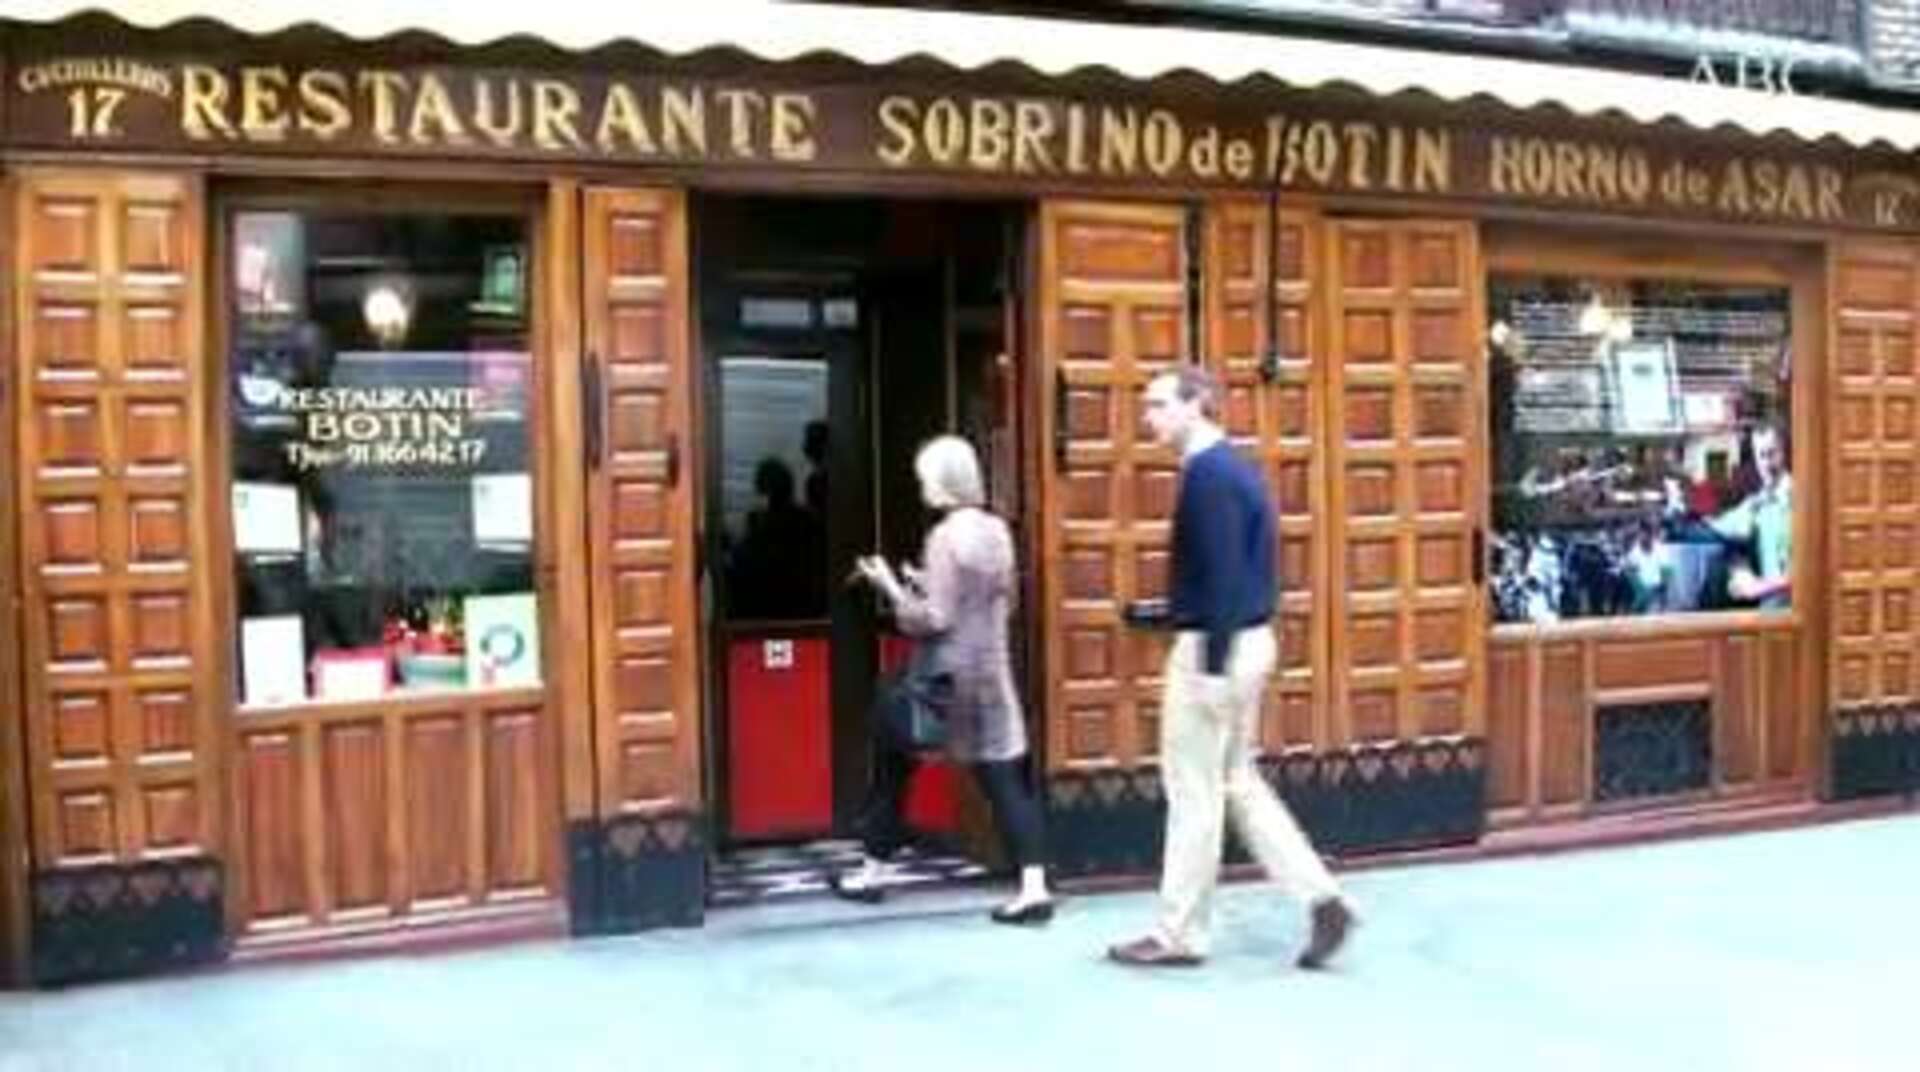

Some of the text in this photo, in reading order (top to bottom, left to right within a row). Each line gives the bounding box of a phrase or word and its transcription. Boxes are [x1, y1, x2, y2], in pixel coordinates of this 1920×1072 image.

[67, 86, 127, 138] 17
[180, 64, 818, 161] RESTAURANTE
[876, 96, 1182, 175] SOBRINO
[1189, 126, 1253, 180] de
[1488, 136, 1650, 200] HORNO
[1662, 158, 1709, 205] de
[1715, 158, 1847, 220] ASAR
[279, 387, 478, 410] RESTAURANTE
[307, 411, 462, 441] BOTIN
